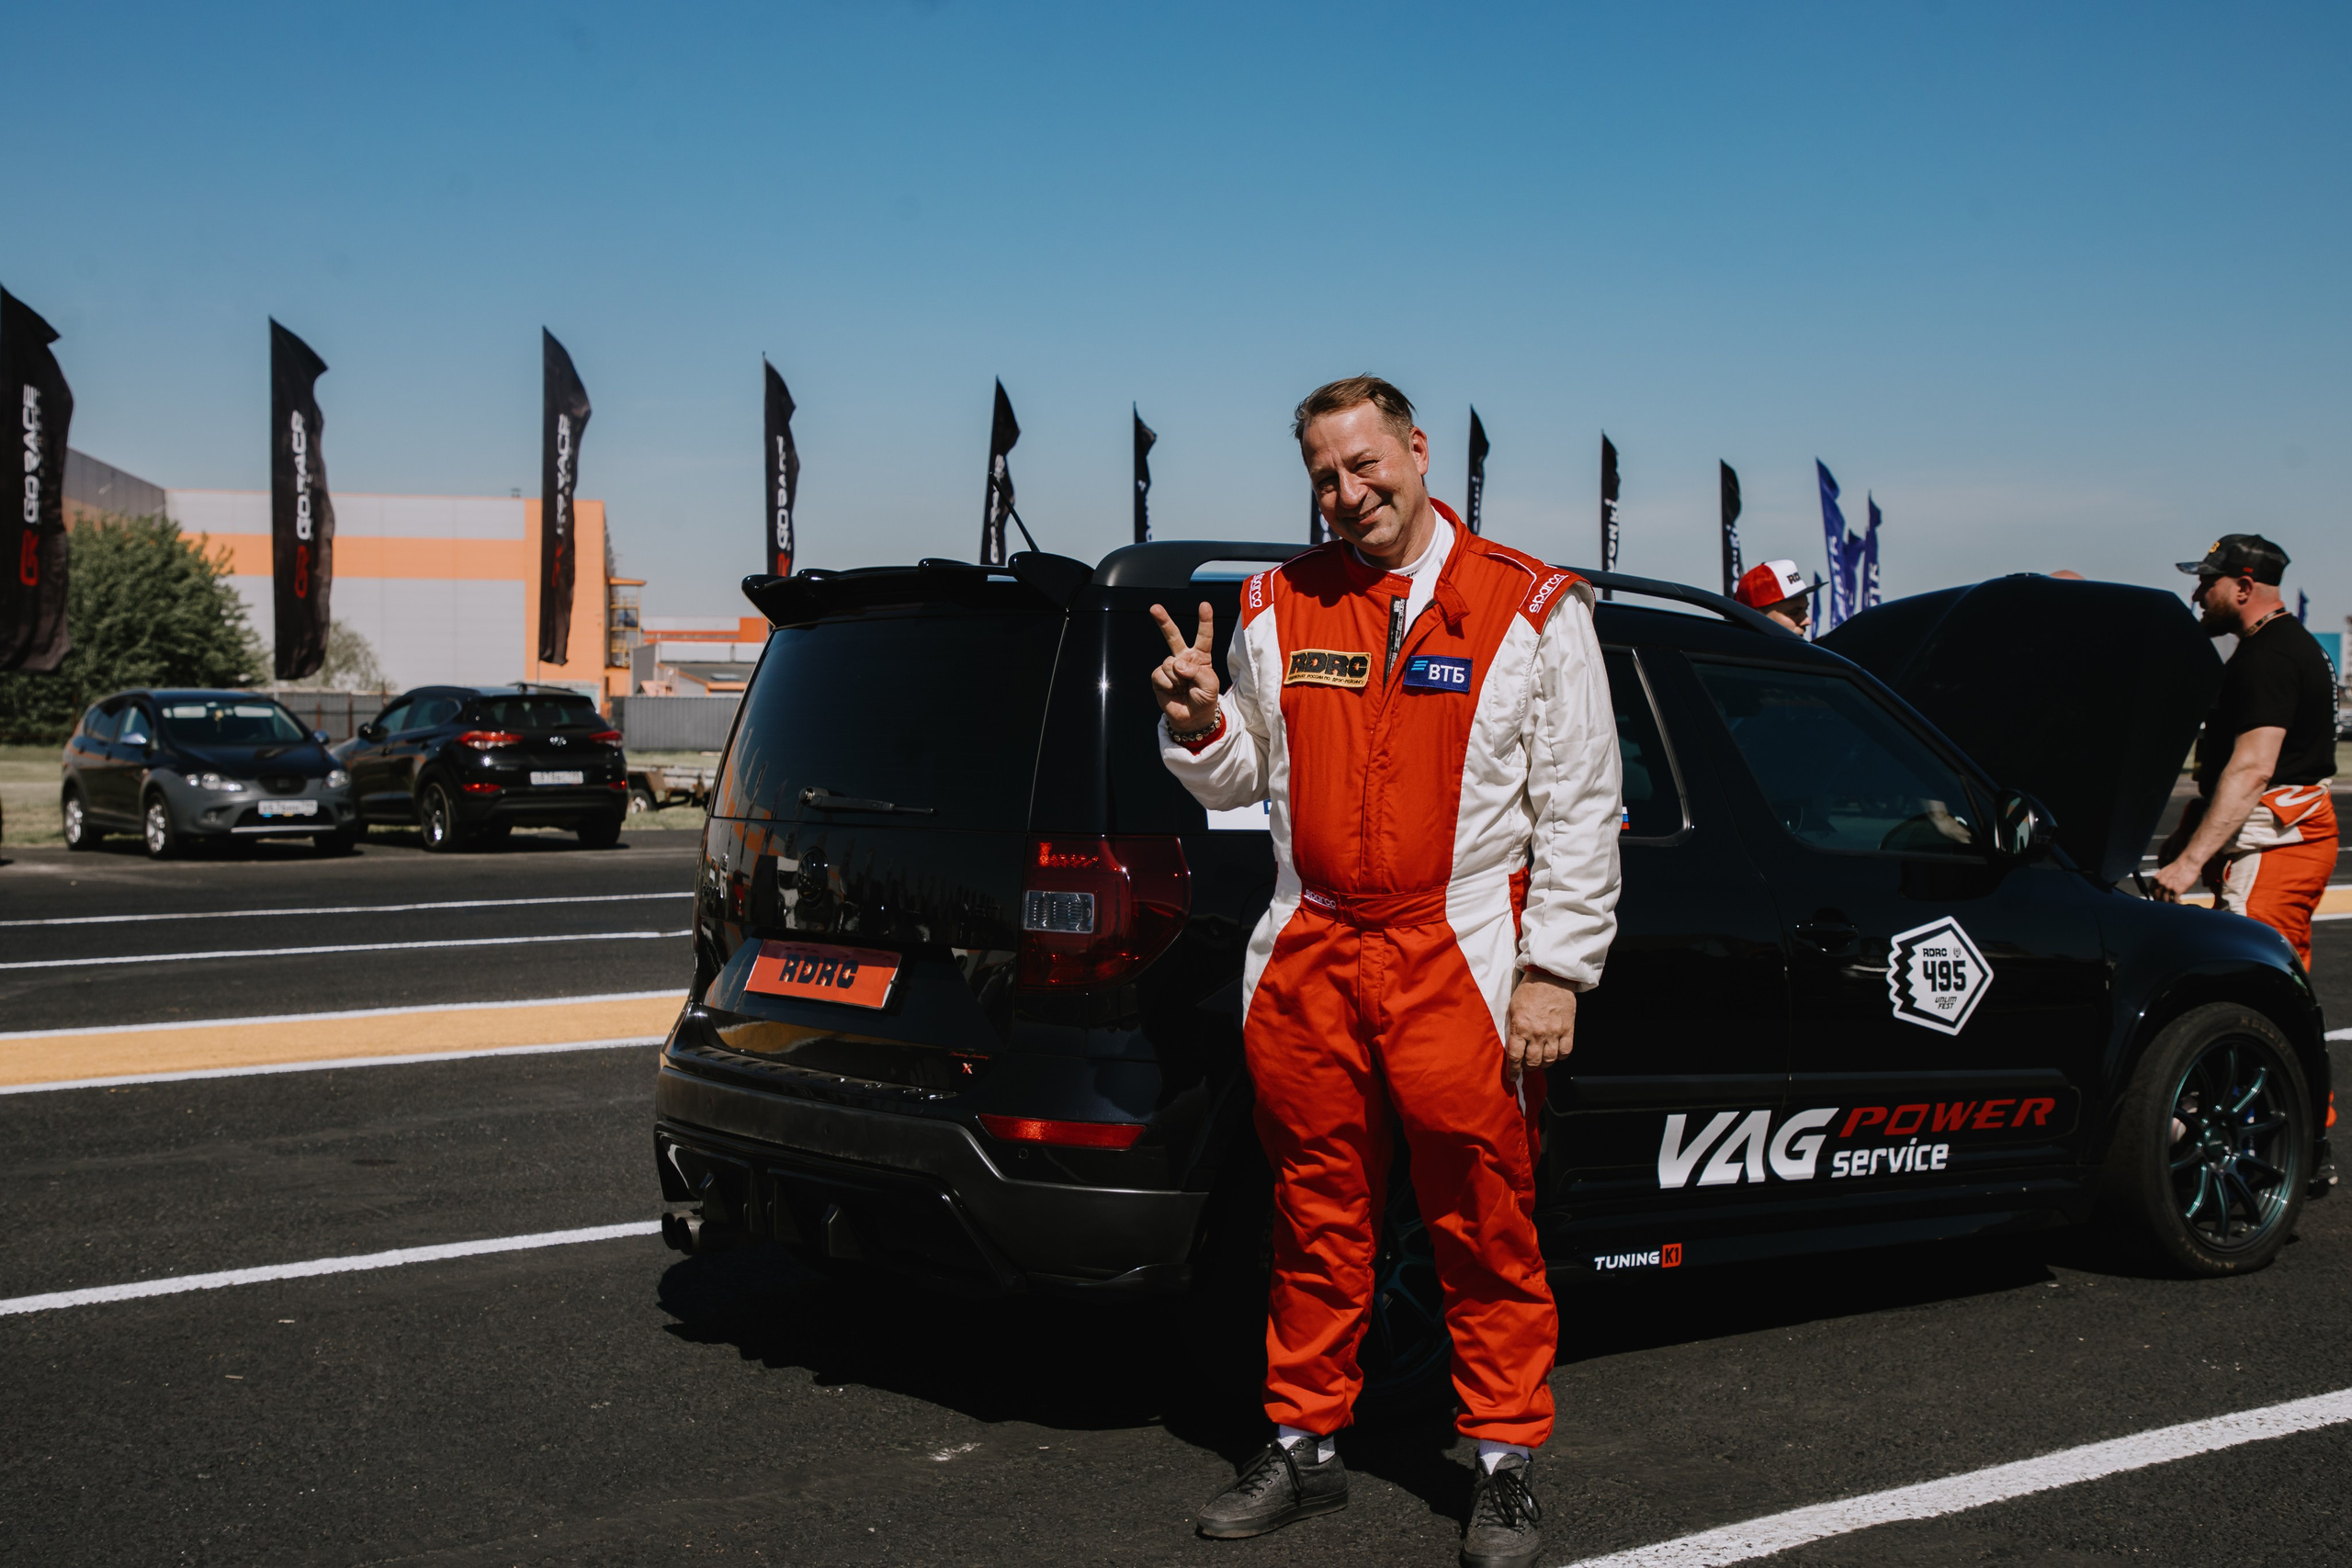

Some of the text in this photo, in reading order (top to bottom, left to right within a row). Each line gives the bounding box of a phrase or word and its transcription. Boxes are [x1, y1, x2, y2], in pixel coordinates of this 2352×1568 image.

[1529, 574, 1566, 614] sparco
[1289, 652, 1368, 678] RDRC
[1428, 663, 1465, 683] ВТБ
[1306, 889, 1337, 909] sparco
[1922, 948, 1947, 957] RDRC
[779, 953, 859, 989] RDRC
[1923, 960, 1966, 992] 495
[1657, 1098, 2056, 1190] VAG POWER
[1831, 1137, 1949, 1179] service
[1594, 1251, 1660, 1270] TUNING
